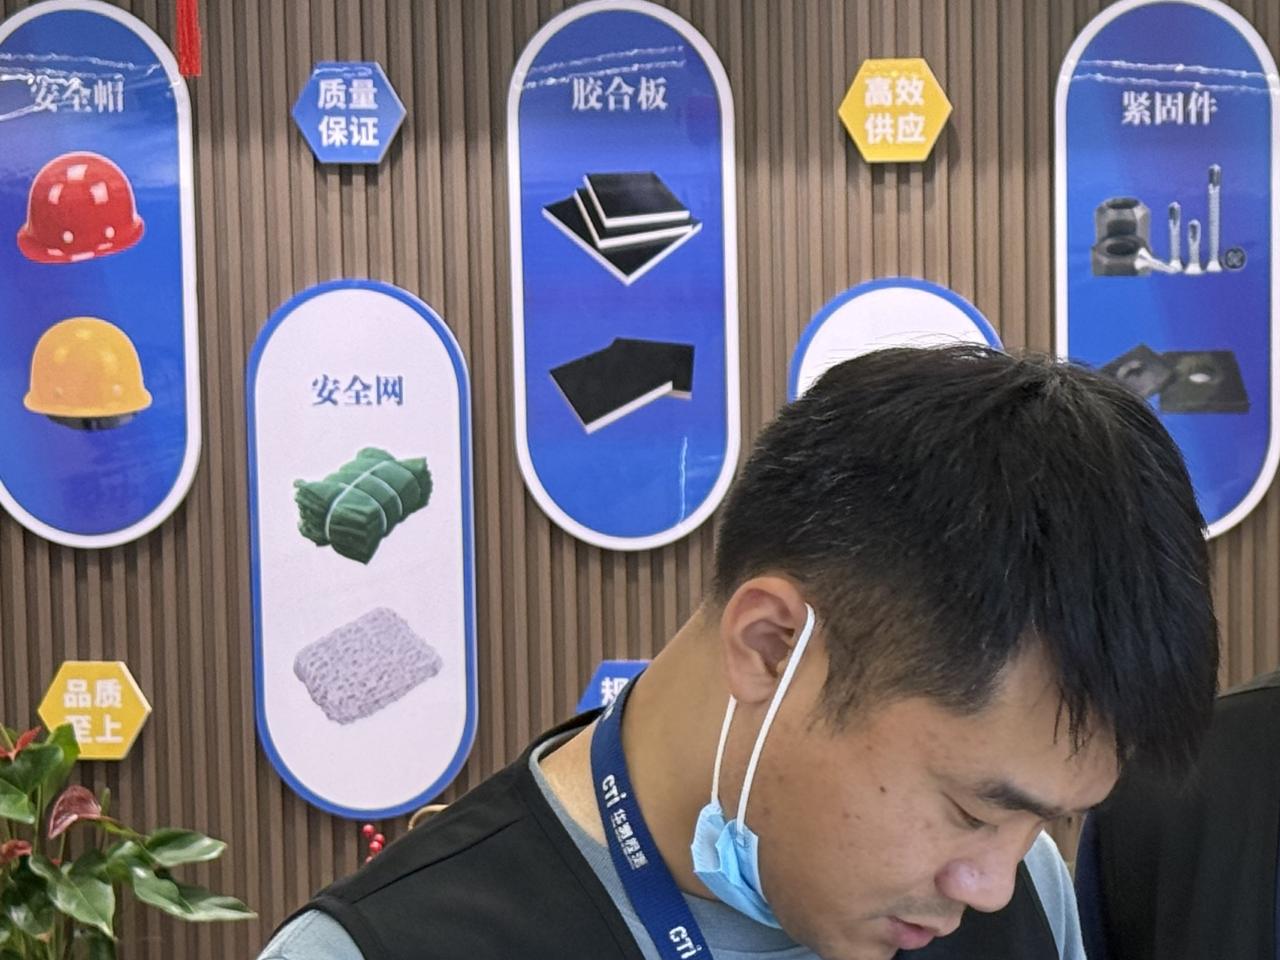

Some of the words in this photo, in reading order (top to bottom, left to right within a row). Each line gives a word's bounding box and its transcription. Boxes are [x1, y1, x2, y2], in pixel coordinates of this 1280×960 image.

[30, 74, 124, 113] 安全帽
[317, 78, 379, 110] 质量
[572, 76, 668, 111] 胶合板
[864, 75, 925, 108] 高效
[1121, 91, 1218, 125] 紧固件
[318, 115, 380, 147] 保证
[864, 112, 926, 145] 供应
[312, 374, 404, 406] 安全网
[63, 679, 122, 708] 品质
[64, 714, 124, 743] 至上
